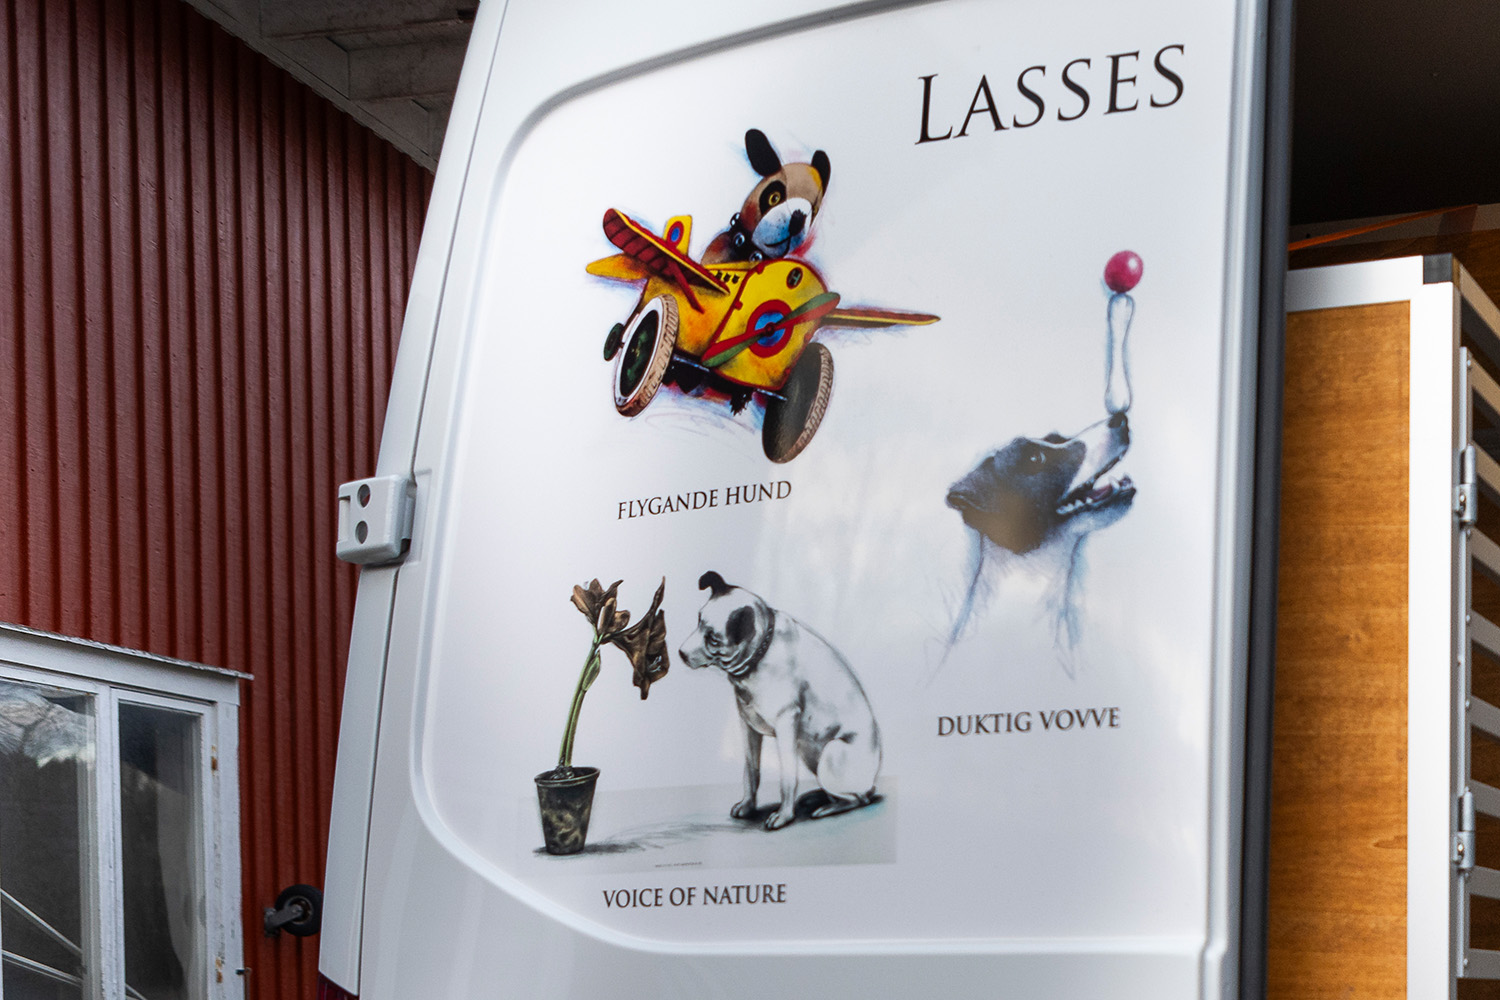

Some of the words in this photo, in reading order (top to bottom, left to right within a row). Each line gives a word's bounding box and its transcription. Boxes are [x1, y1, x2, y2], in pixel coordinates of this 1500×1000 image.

[915, 44, 1185, 145] LASSES
[617, 489, 719, 520] FLYGANDE
[724, 479, 792, 506] HUND
[937, 711, 1032, 736] DUKTIG
[1039, 706, 1121, 730] VOVVE
[603, 888, 663, 908] VOICE
[669, 887, 697, 907] OF
[703, 883, 787, 906] NATURE
